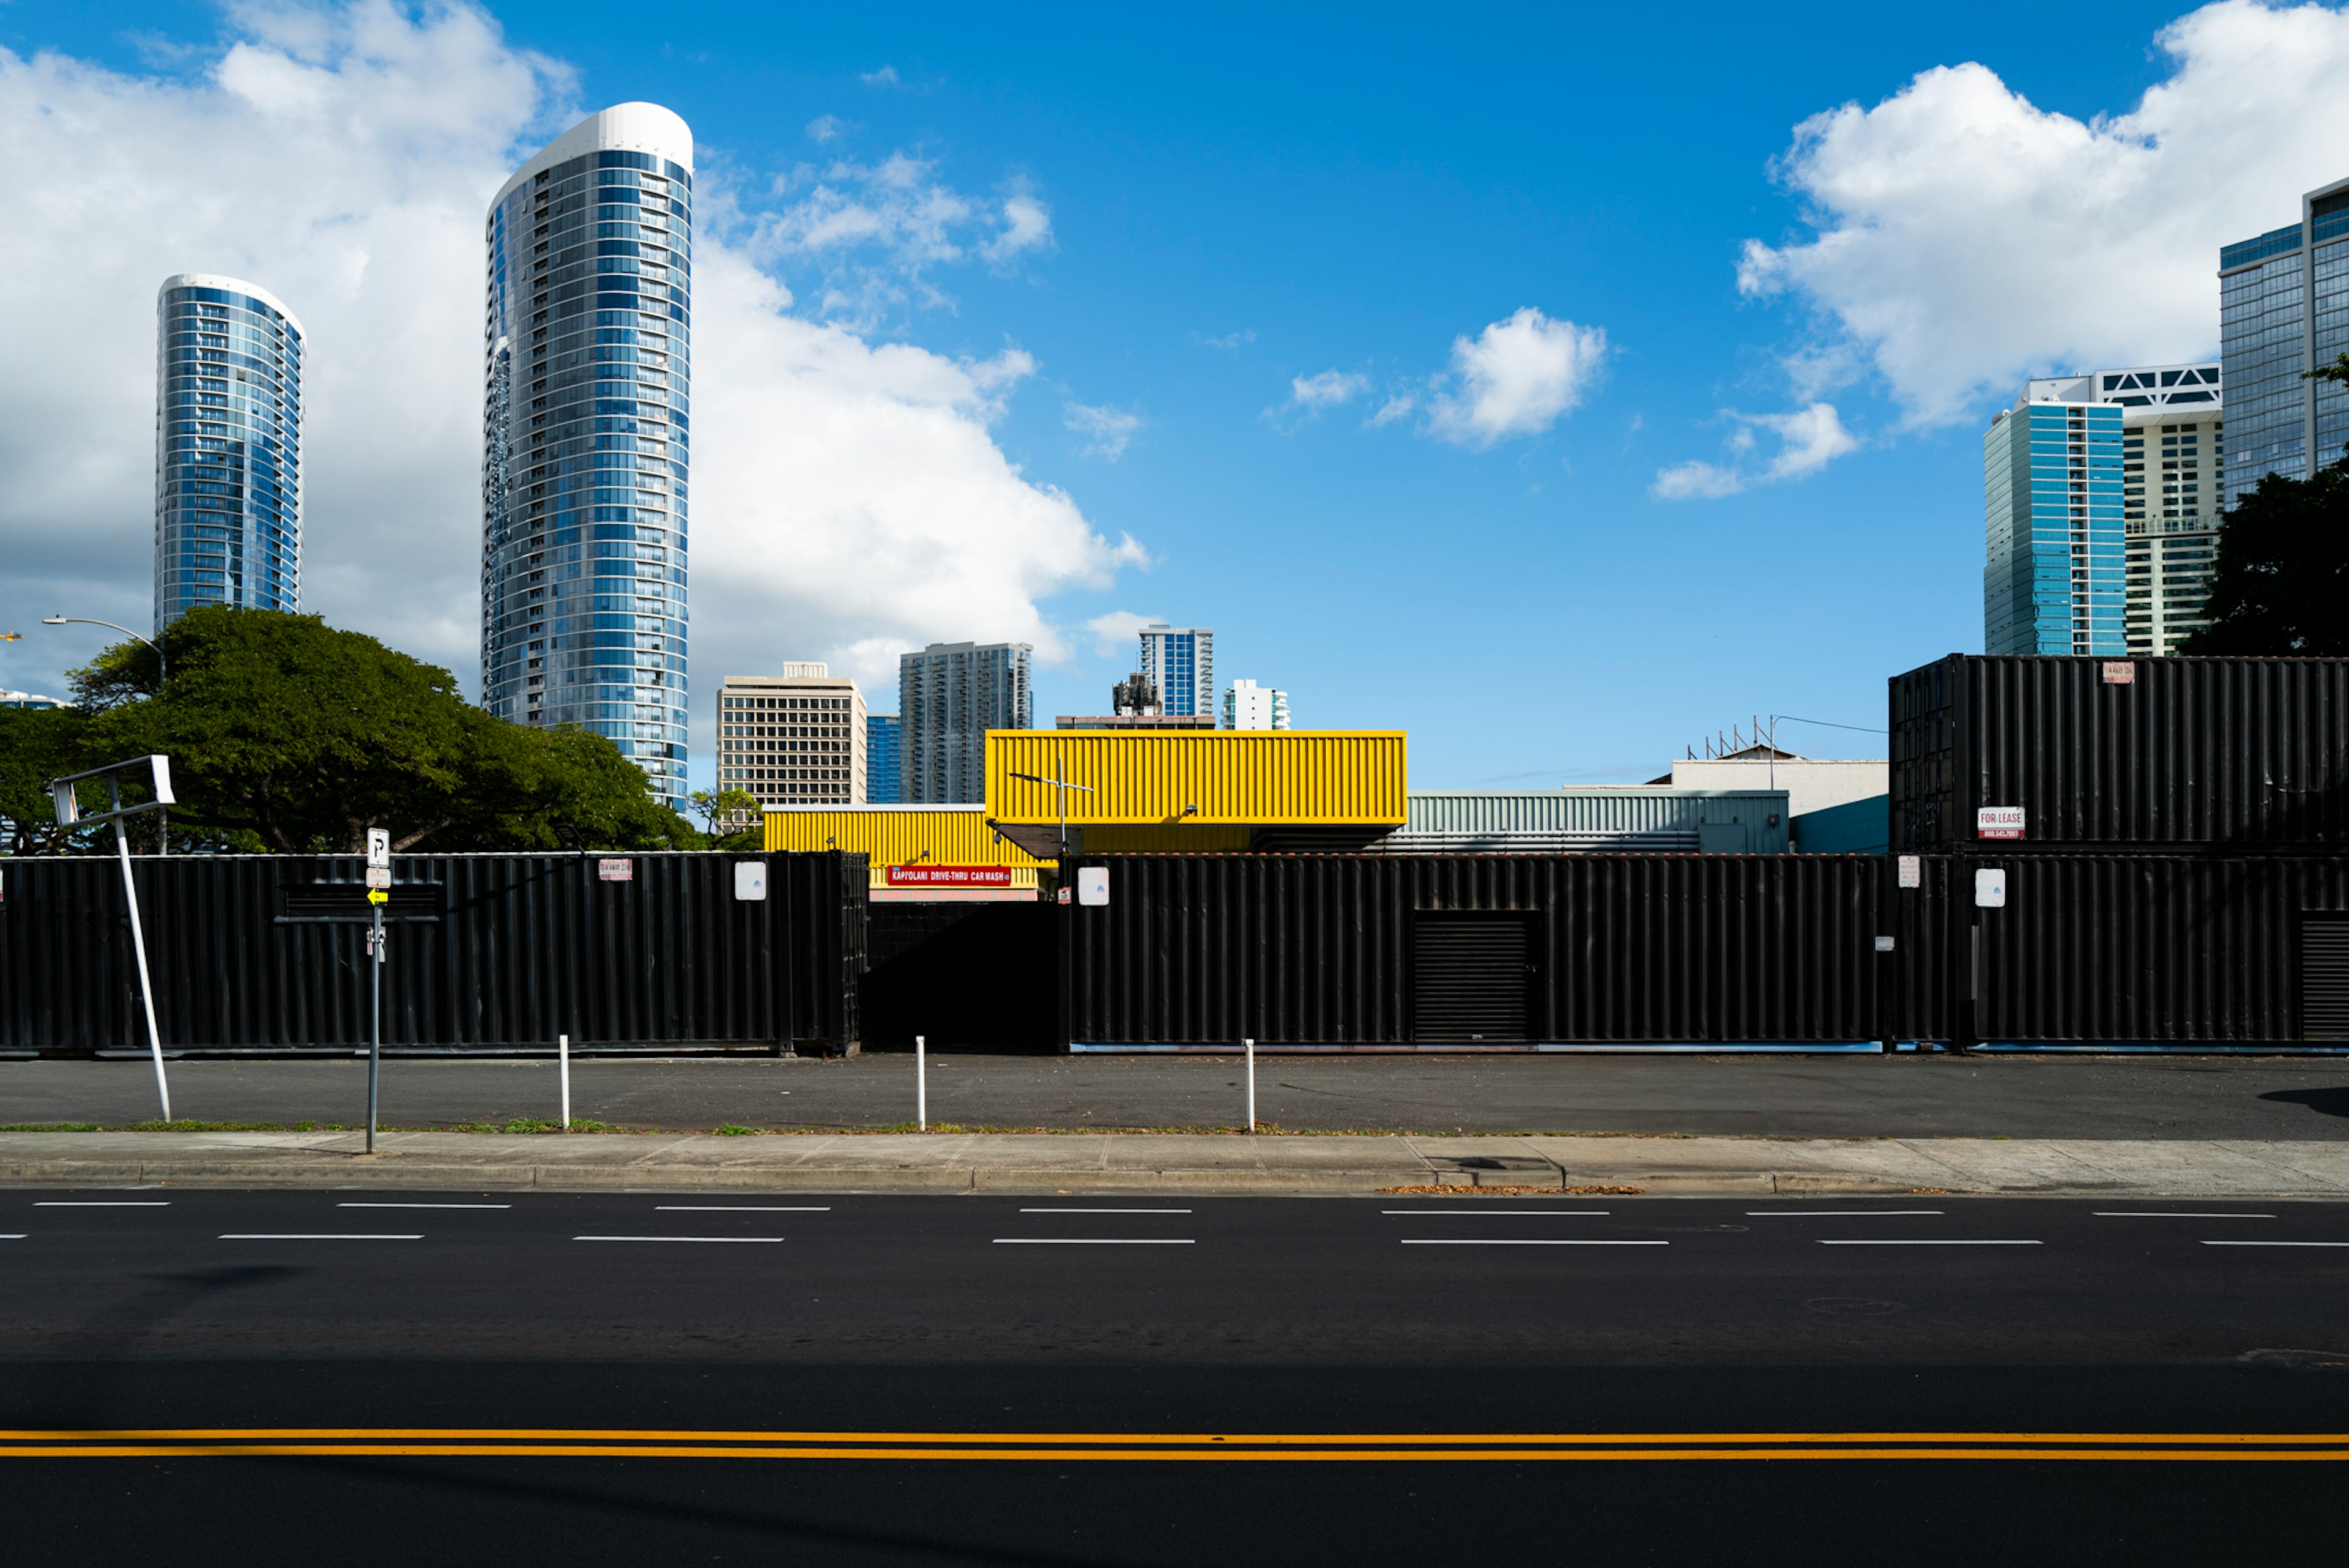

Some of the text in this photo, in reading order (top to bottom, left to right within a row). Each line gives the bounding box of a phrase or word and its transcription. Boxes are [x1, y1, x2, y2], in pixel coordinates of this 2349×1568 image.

[1981, 813, 2021, 823] FOR LEASE
[931, 871, 968, 880] DRIVE-THRU
[971, 871, 984, 881] CAR
[985, 872, 1004, 881] WASH
